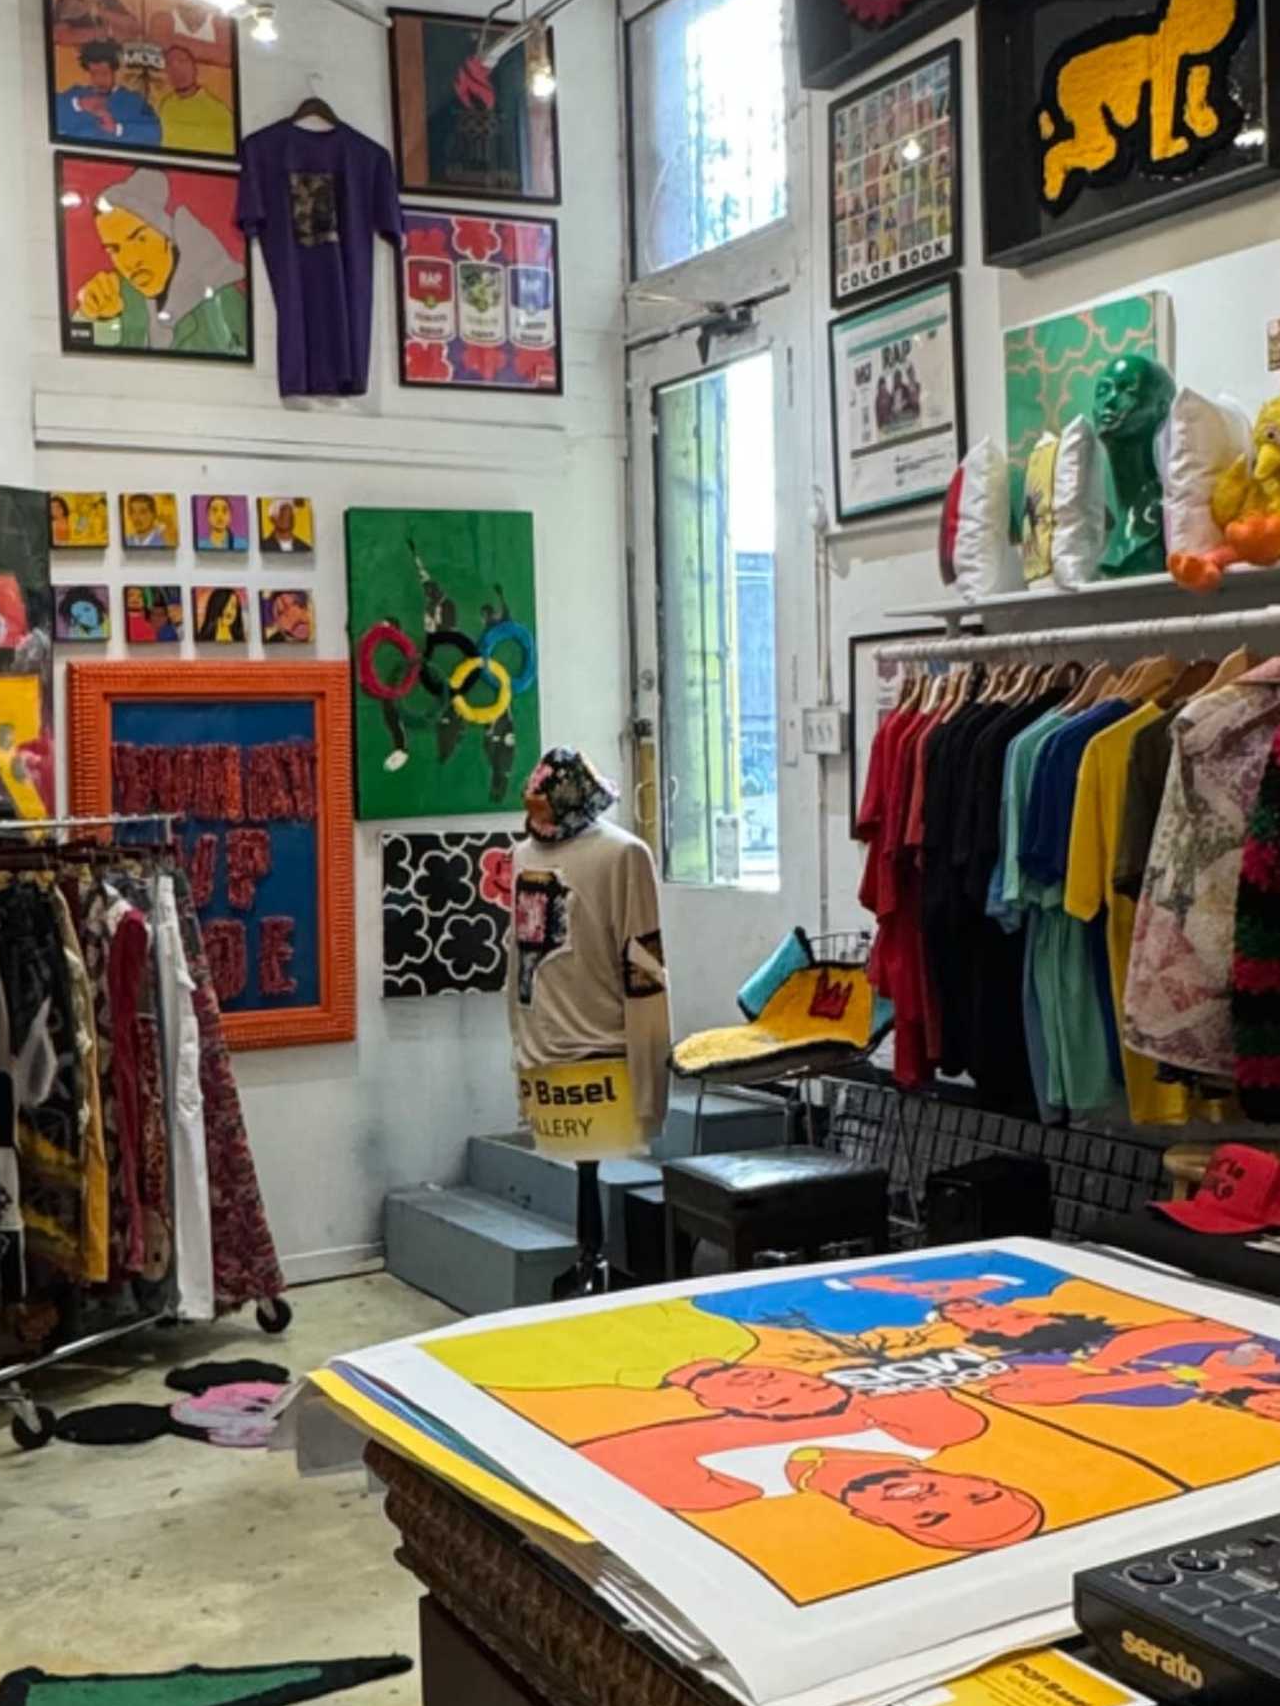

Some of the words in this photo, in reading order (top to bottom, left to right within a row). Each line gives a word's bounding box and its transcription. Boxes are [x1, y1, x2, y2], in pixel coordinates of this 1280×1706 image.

[840, 260, 893, 293] COLOR
[898, 239, 947, 271] BOOK
[535, 1076, 618, 1106] Basel
[533, 1116, 594, 1138] LLERY
[1120, 1629, 1204, 1690] serato
